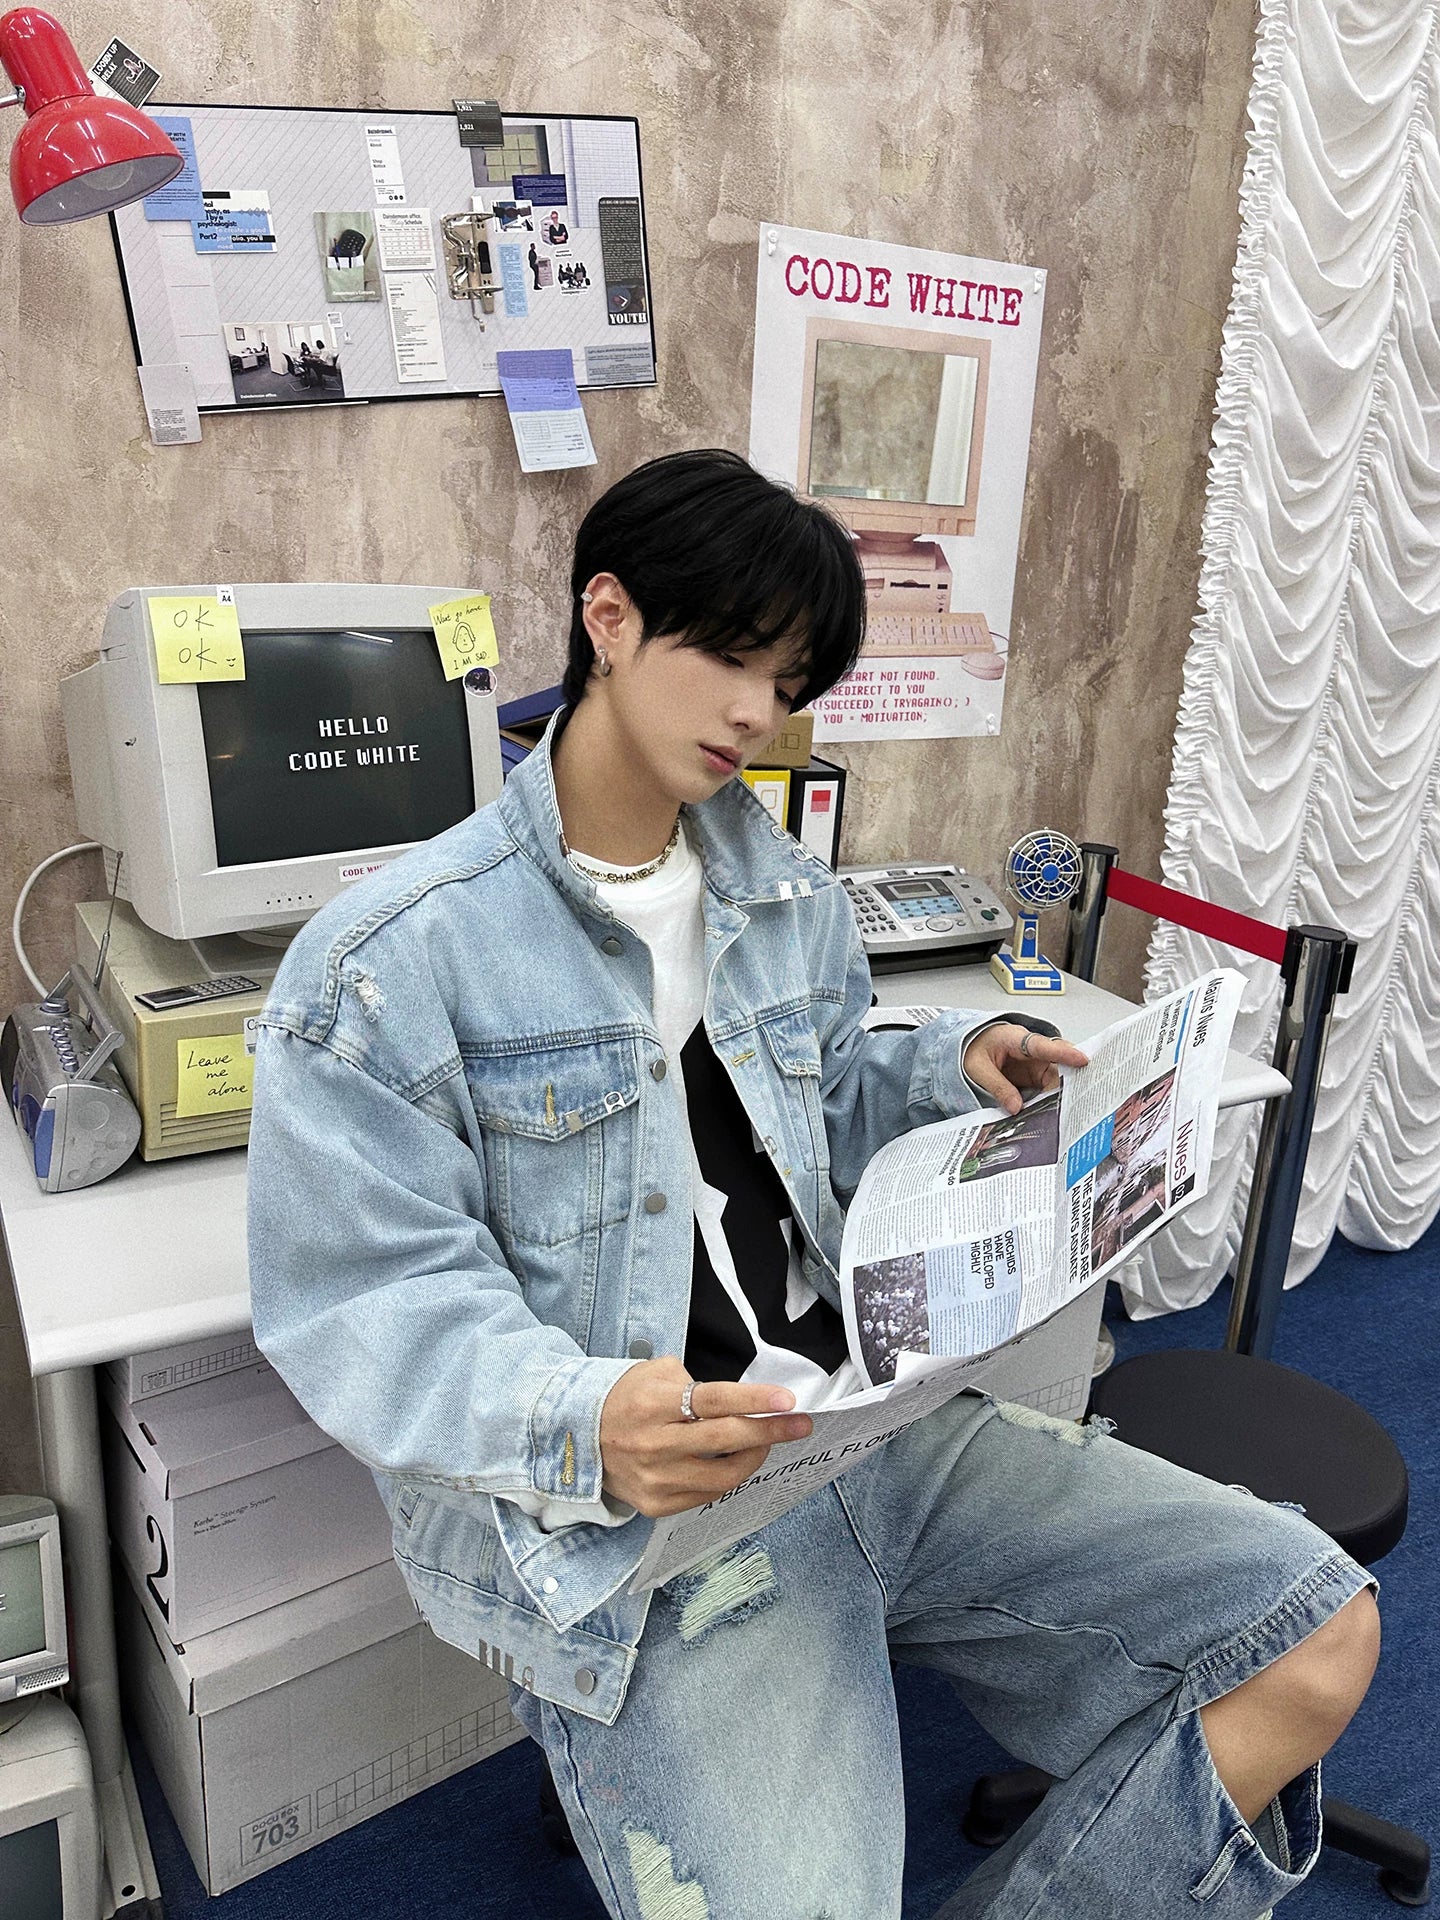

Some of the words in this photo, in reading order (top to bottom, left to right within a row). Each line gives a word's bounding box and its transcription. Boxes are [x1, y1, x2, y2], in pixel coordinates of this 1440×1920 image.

[93, 51, 113, 75] LOOSEN
[109, 43, 118, 54] UP
[101, 61, 118, 82] RELAX
[199, 232, 218, 240] Part2
[785, 255, 892, 308] CODE
[906, 272, 1024, 327] WHITE
[609, 311, 648, 325] YOUTH
[173, 604, 215, 632] OK
[455, 611, 463, 623] go
[453, 659, 459, 671] I
[462, 656, 472, 666] AM
[880, 671, 900, 682] NOT
[904, 670, 940, 682] FOUND.
[832, 685, 882, 696] REDIRECT
[889, 685, 900, 695] TO
[907, 684, 925, 695] YOU
[318, 715, 389, 738] HELLO
[823, 713, 843, 724] YOU
[289, 748, 347, 772] CODE
[356, 744, 421, 767] WHITE
[342, 867, 365, 877] CODE
[1200, 976, 1224, 1014] Mauris
[1160, 1003, 1174, 1029] humid
[1170, 1006, 1181, 1029] warm
[1166, 1028, 1176, 1045] and
[1192, 1012, 1215, 1048] Nwes
[1152, 1029, 1167, 1063] climates
[187, 1050, 233, 1070] Leave
[206, 1069, 229, 1080] me
[207, 1081, 249, 1097] alone
[1174, 1118, 1194, 1182] Nwes
[947, 1175, 956, 1186] do
[1082, 1172, 1094, 1198] THE
[1173, 1184, 1185, 1203] 02
[1070, 1185, 1081, 1233] ALWAYS
[1080, 1197, 1092, 1255] STAMENS
[970, 1240, 981, 1275] HIGHLY
[994, 1233, 1004, 1261] HAVE
[1004, 1229, 1017, 1275] ORCHIDS
[1069, 1232, 1079, 1284] ADNATE
[982, 1237, 995, 1290] DEVELOPED
[1079, 1255, 1089, 1284] ARE
[698, 1501, 713, 1516] A
[719, 1449, 834, 1504] BEAUTIFUL
[840, 1417, 923, 1458] FLOWE
[249, 1494, 277, 1510] System
[146, 1514, 170, 1625] 2
[252, 1814, 279, 1833] DOCU
[281, 1804, 300, 1819] BOX
[252, 1815, 300, 1855] 703
